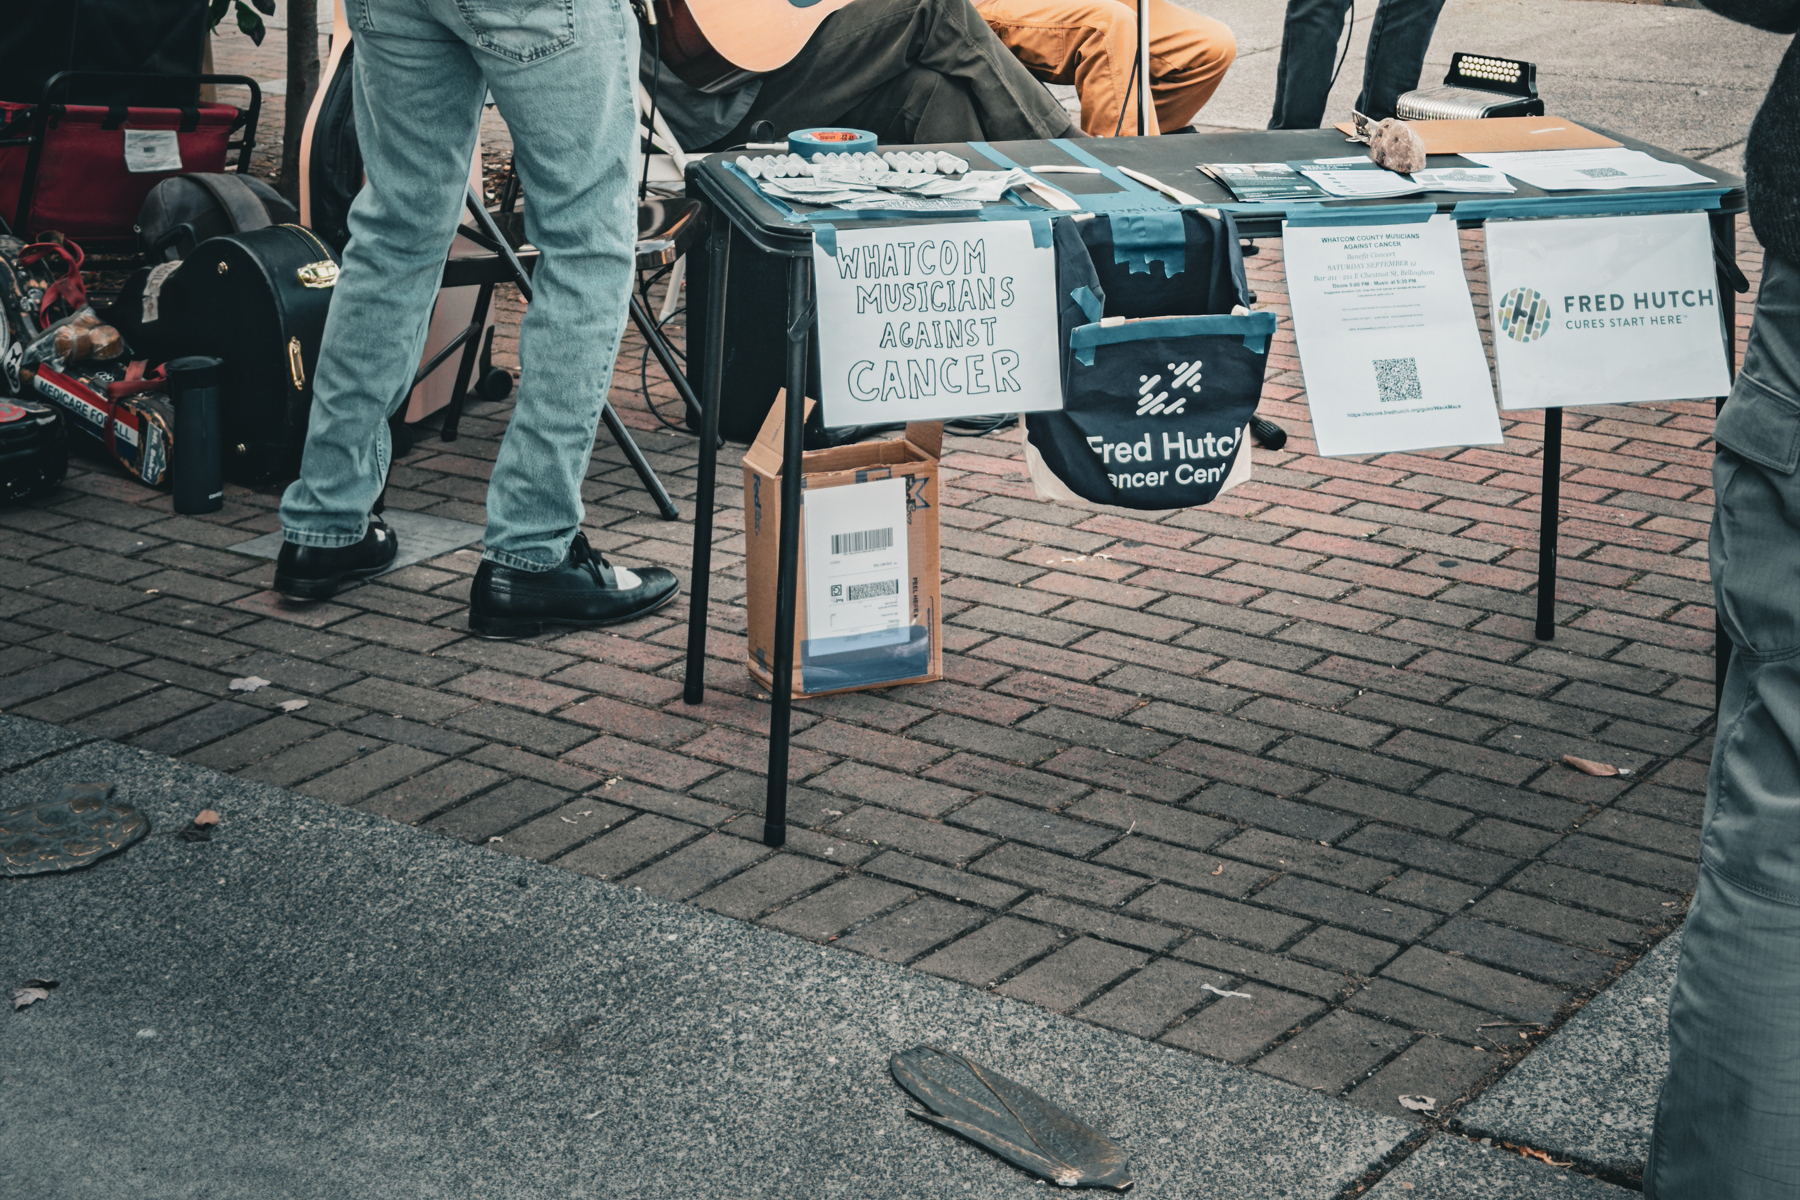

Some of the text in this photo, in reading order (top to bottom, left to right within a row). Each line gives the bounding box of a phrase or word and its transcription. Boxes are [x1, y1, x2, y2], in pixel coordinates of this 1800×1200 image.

[1344, 240, 1402, 250] AGAINST CANCER
[1357, 234, 1383, 242] COUNTY
[1386, 232, 1420, 240] MUSICIANS
[836, 238, 986, 279] WHATCOM
[1327, 262, 1366, 271] SATURDAY
[1366, 260, 1409, 269] SEPTEMBER
[1346, 251, 1396, 261] Benefit Concert
[1400, 268, 1435, 277] Bellingham
[856, 276, 1015, 314] MUSICIANS
[1563, 288, 1714, 314] FRED HUTCH
[1565, 319, 1605, 330] CURES
[1610, 316, 1645, 328] START
[879, 317, 997, 350] AGAINST
[848, 349, 1021, 402] CANCER
[40, 380, 88, 418] MEDICARE
[114, 421, 131, 441] ALL
[1107, 469, 1169, 488] ancer
